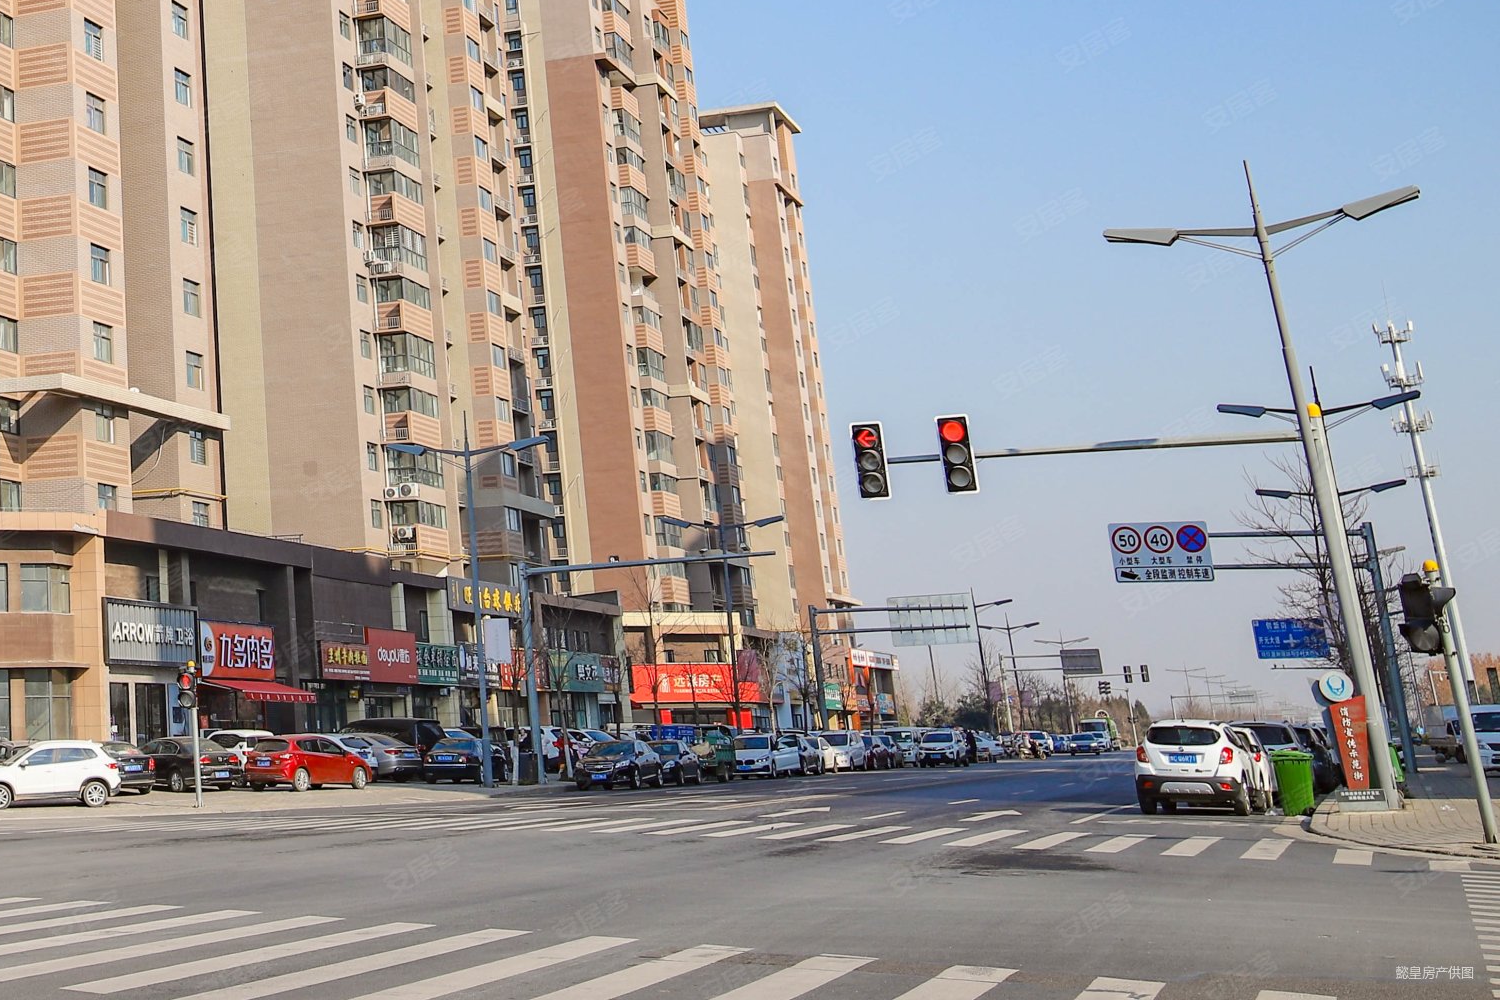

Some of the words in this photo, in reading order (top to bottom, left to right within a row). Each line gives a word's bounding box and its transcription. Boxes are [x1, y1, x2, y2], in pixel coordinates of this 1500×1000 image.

[1119, 534, 1136, 547] 50
[1150, 533, 1168, 547] 40
[1119, 557, 1140, 566] 小型车
[1151, 556, 1173, 565] 大型车
[1186, 555, 1203, 564] 禁停
[1145, 568, 1176, 580] 全段监测
[1178, 568, 1210, 580] 控制车速
[112, 621, 154, 643] ARROW
[155, 624, 195, 646] 箭牌卫浴
[219, 633, 273, 670] 九多肉多
[1339, 707, 1364, 781] 消防宣传示范街
